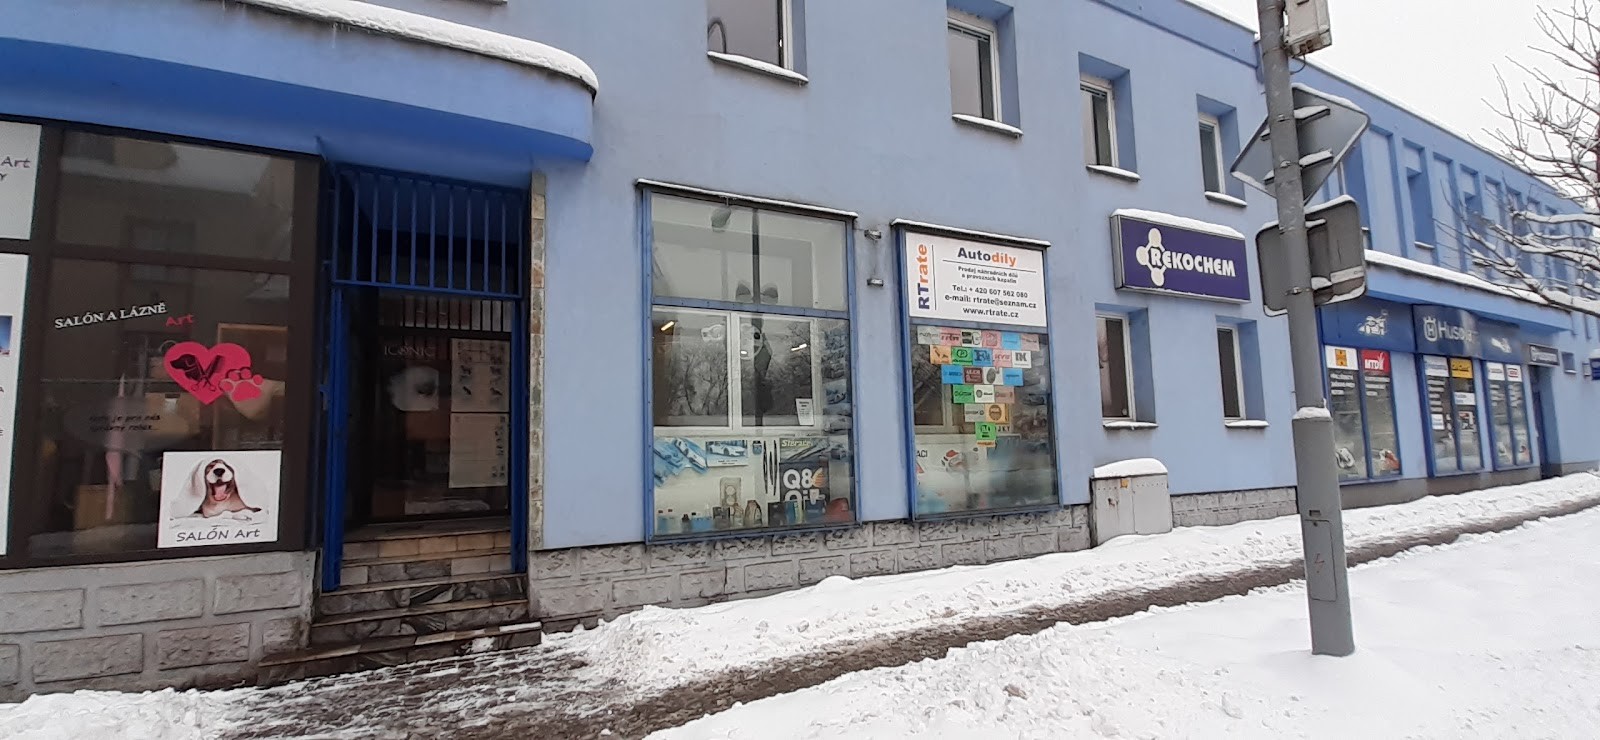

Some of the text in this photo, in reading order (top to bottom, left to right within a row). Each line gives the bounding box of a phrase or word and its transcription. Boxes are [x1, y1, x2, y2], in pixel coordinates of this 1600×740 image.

[1, 156, 31, 169] Art
[1150, 247, 1236, 277] REKOCHEM
[917, 244, 930, 310] RTrate
[958, 266, 976, 274] Prodej
[975, 287, 988, 295] 420
[945, 293, 1037, 309] e-mail: rtrate@seznam.cz
[54, 302, 167, 330] SALÓN A LÁZNĚ
[963, 306, 1019, 318] www.rtrate.cz
[166, 314, 193, 327] Art
[783, 468, 813, 489] Q8
[176, 527, 261, 542] SALÓN Art
